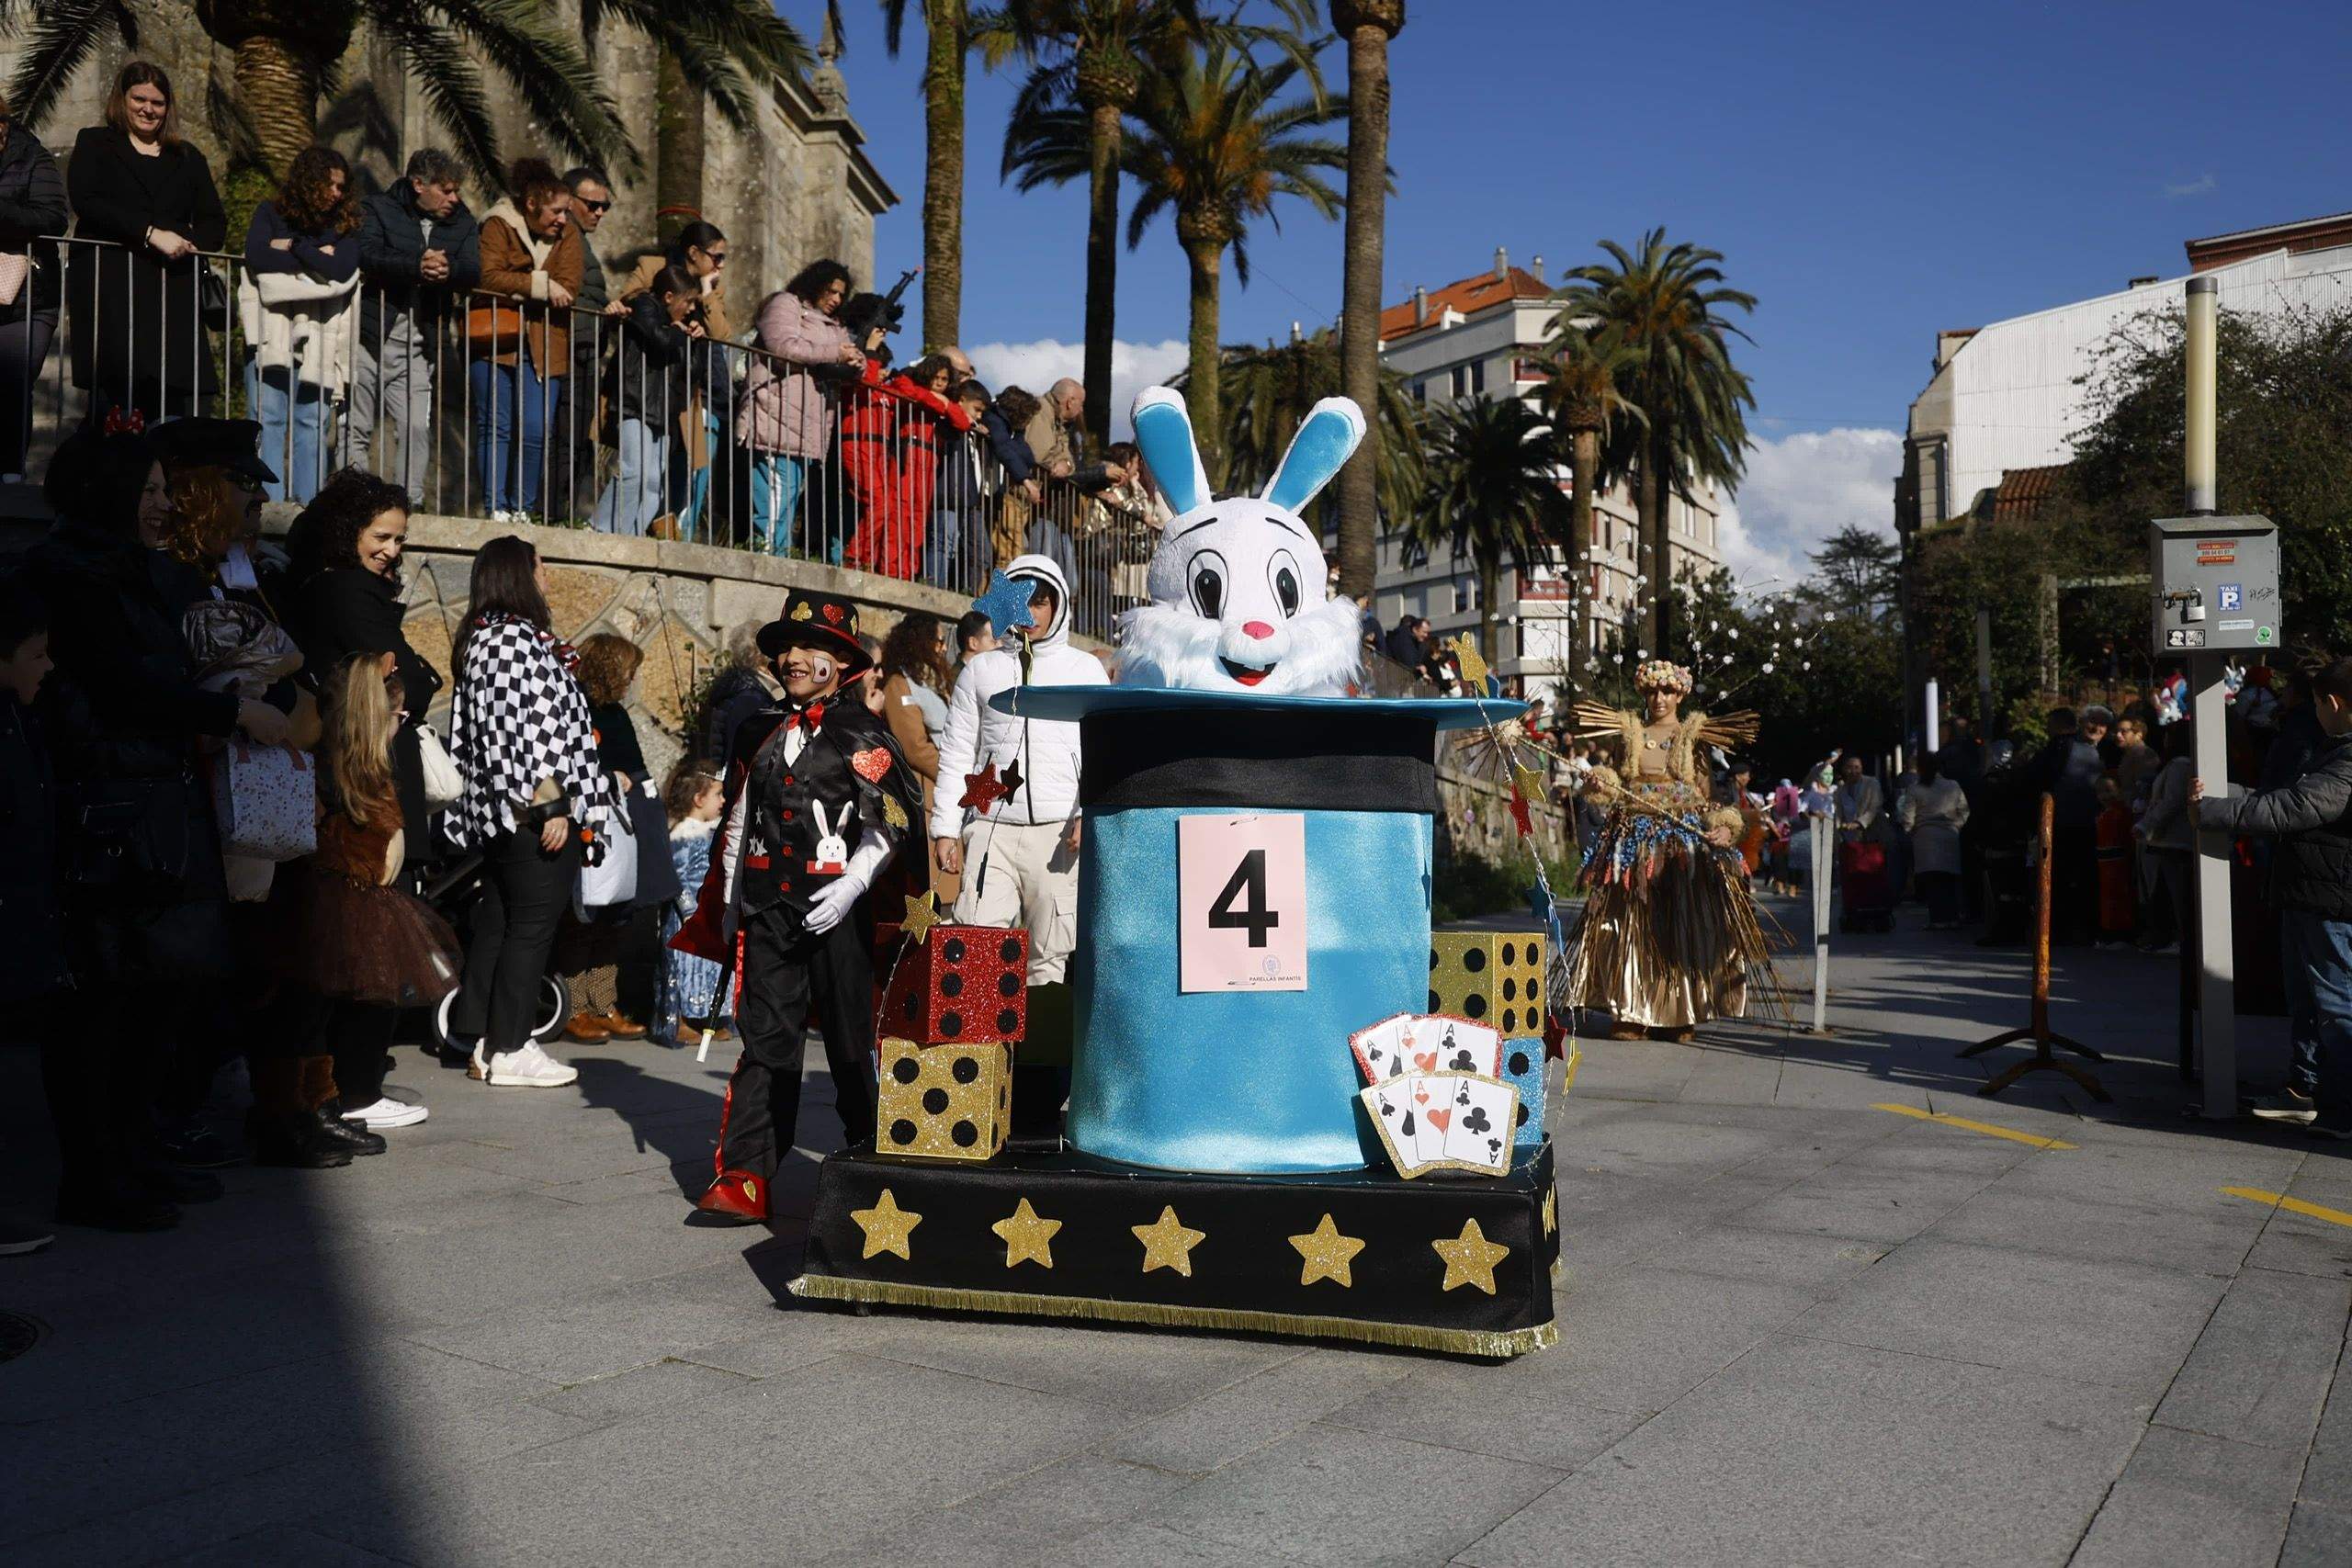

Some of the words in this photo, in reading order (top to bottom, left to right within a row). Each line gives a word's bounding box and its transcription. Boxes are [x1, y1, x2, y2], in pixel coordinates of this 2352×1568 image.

[2222, 592, 2238, 607] P
[1208, 850, 1279, 947] 4
[1403, 1025, 1412, 1036] A
[1446, 1023, 1454, 1036] A
[1367, 1039, 1375, 1049] A
[1417, 1080, 1425, 1092] A
[1460, 1080, 1469, 1093] A
[1379, 1092, 1387, 1104] A
[1489, 1152, 1498, 1164] A
